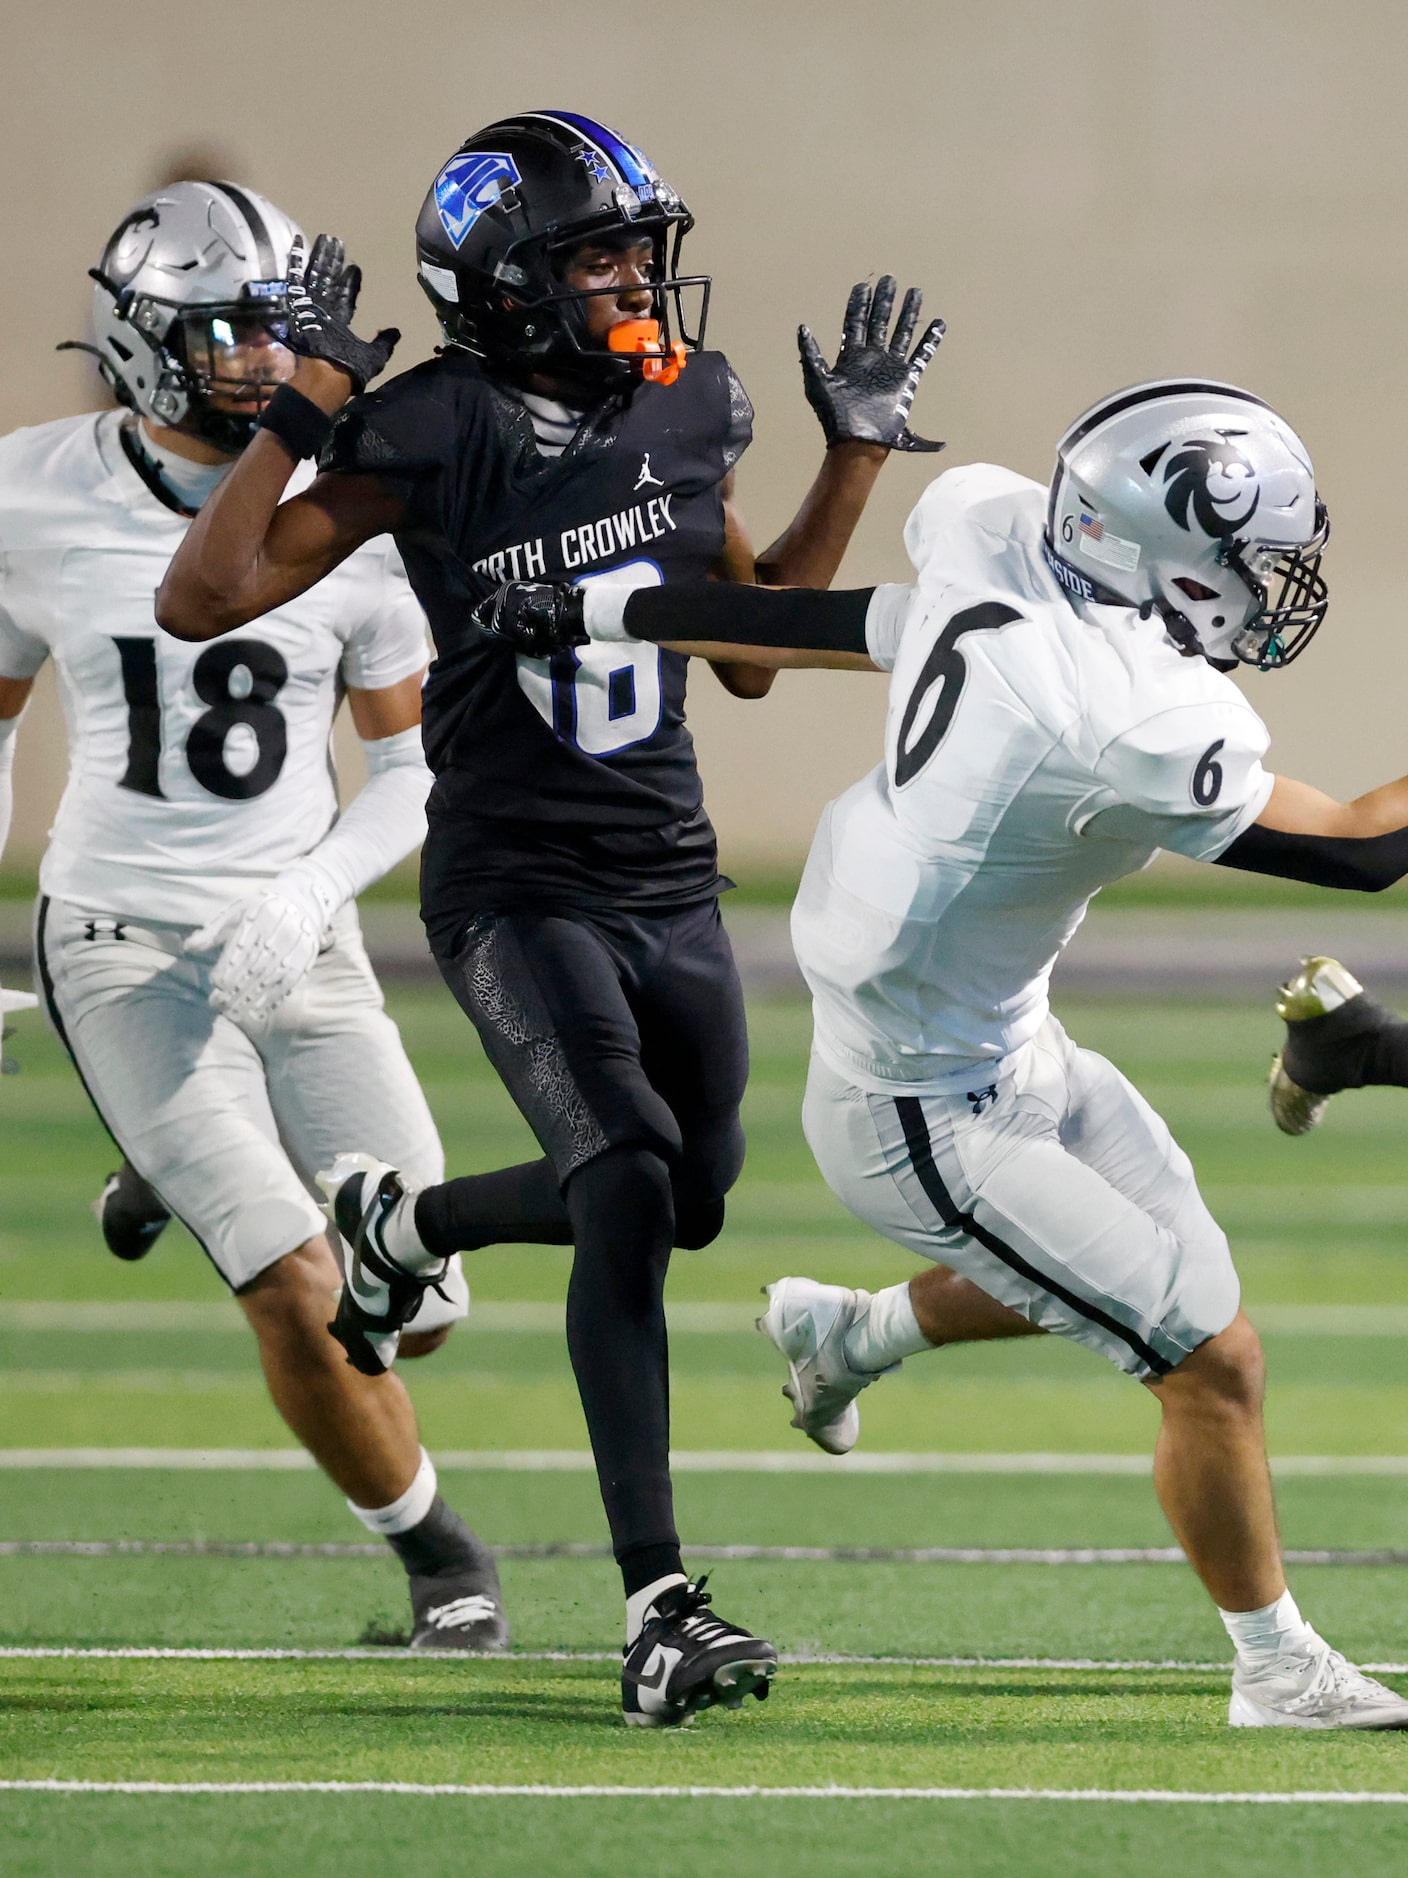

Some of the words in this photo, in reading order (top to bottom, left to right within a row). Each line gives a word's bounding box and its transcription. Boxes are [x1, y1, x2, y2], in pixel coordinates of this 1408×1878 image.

[893, 326, 944, 420] JORDAN
[560, 493, 677, 569] CROWLEY
[1062, 515, 1075, 543] 6
[110, 636, 289, 800] 18
[895, 600, 1026, 788] 6
[1192, 737, 1226, 807] 6
